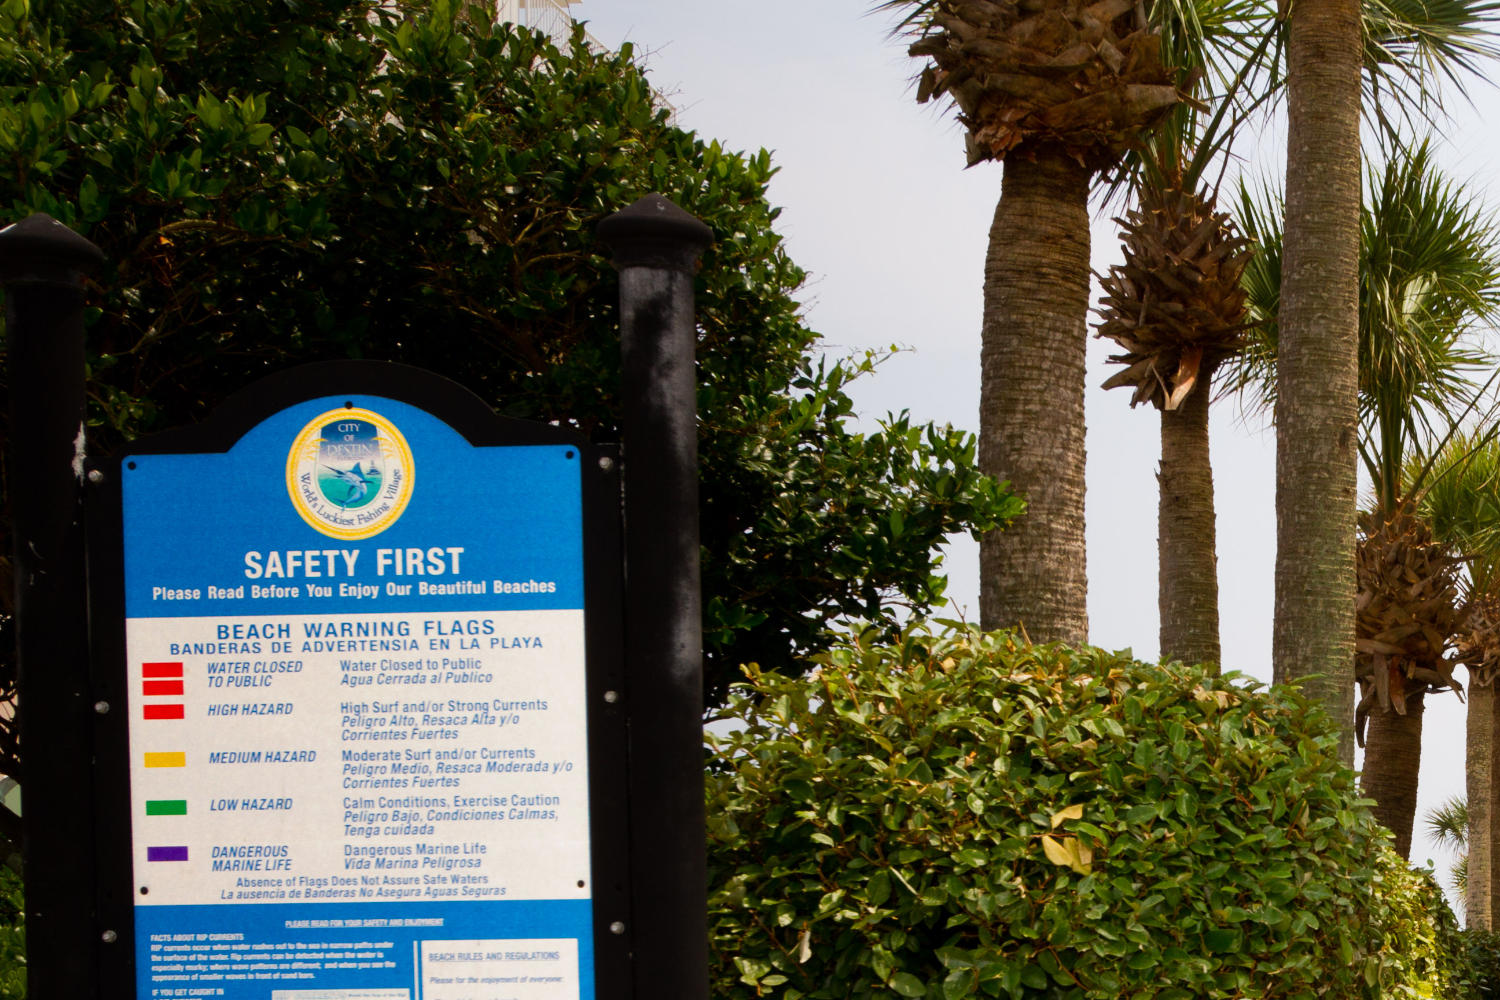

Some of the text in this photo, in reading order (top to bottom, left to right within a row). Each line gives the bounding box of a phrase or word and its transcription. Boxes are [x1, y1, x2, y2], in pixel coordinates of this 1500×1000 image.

[338, 423, 360, 432] CITY
[344, 434, 355, 442] OF
[327, 444, 373, 457] DESTIN
[300, 468, 402, 526] World's Luckiest Fishing Village
[245, 547, 464, 578] SAFETY FIRST
[153, 579, 556, 600] Please Read Before You Enjoy Our Beautiful Beaches
[216, 619, 494, 640] BEACH WARNING FLAGS
[169, 637, 542, 655] BANDERAS DE ADVERTENSIA EN LA PLAYA
[205, 660, 303, 674] WATER CLOSED
[339, 657, 481, 672] Water Closed to Public
[206, 675, 272, 687] TO PUBLIC
[339, 671, 493, 688] Agua Cerrada al Publico
[206, 703, 293, 715] HIGH HAZARD
[340, 699, 547, 716] High Surf and/or Strong Currents
[340, 714, 387, 729] Peligro
[421, 714, 468, 726] Resaca
[470, 712, 496, 724] Alta
[498, 713, 520, 726] y/o
[340, 727, 459, 741] Corrientes Fuertes
[208, 750, 317, 763] MEDIUM HAZARD
[341, 747, 535, 761] Moderate Surf and/or Currents
[342, 762, 388, 777] Peligro
[435, 761, 482, 774] Resaca
[485, 760, 549, 772] Moderada
[552, 762, 573, 773] y/o
[341, 775, 461, 788] Corrientes Fuertes
[210, 798, 292, 810] LOW HAZARD
[343, 796, 375, 809] Calm
[453, 795, 507, 808] Exercise
[511, 794, 559, 807] Caution
[343, 810, 388, 825] Peligro
[426, 808, 504, 821] Condiciones
[342, 824, 381, 838] Tenga
[210, 845, 290, 859] DANGEROUS
[344, 842, 486, 858] Dangerous Marine Life
[211, 859, 292, 872] MARINE LIFE
[342, 856, 482, 871] Vida Marina Peligrosa
[235, 874, 488, 889] Absence of Flags Does Not Assure Safe Waters
[220, 885, 506, 899] La ausencia de Banderas No Asegura Aguas Seguras
